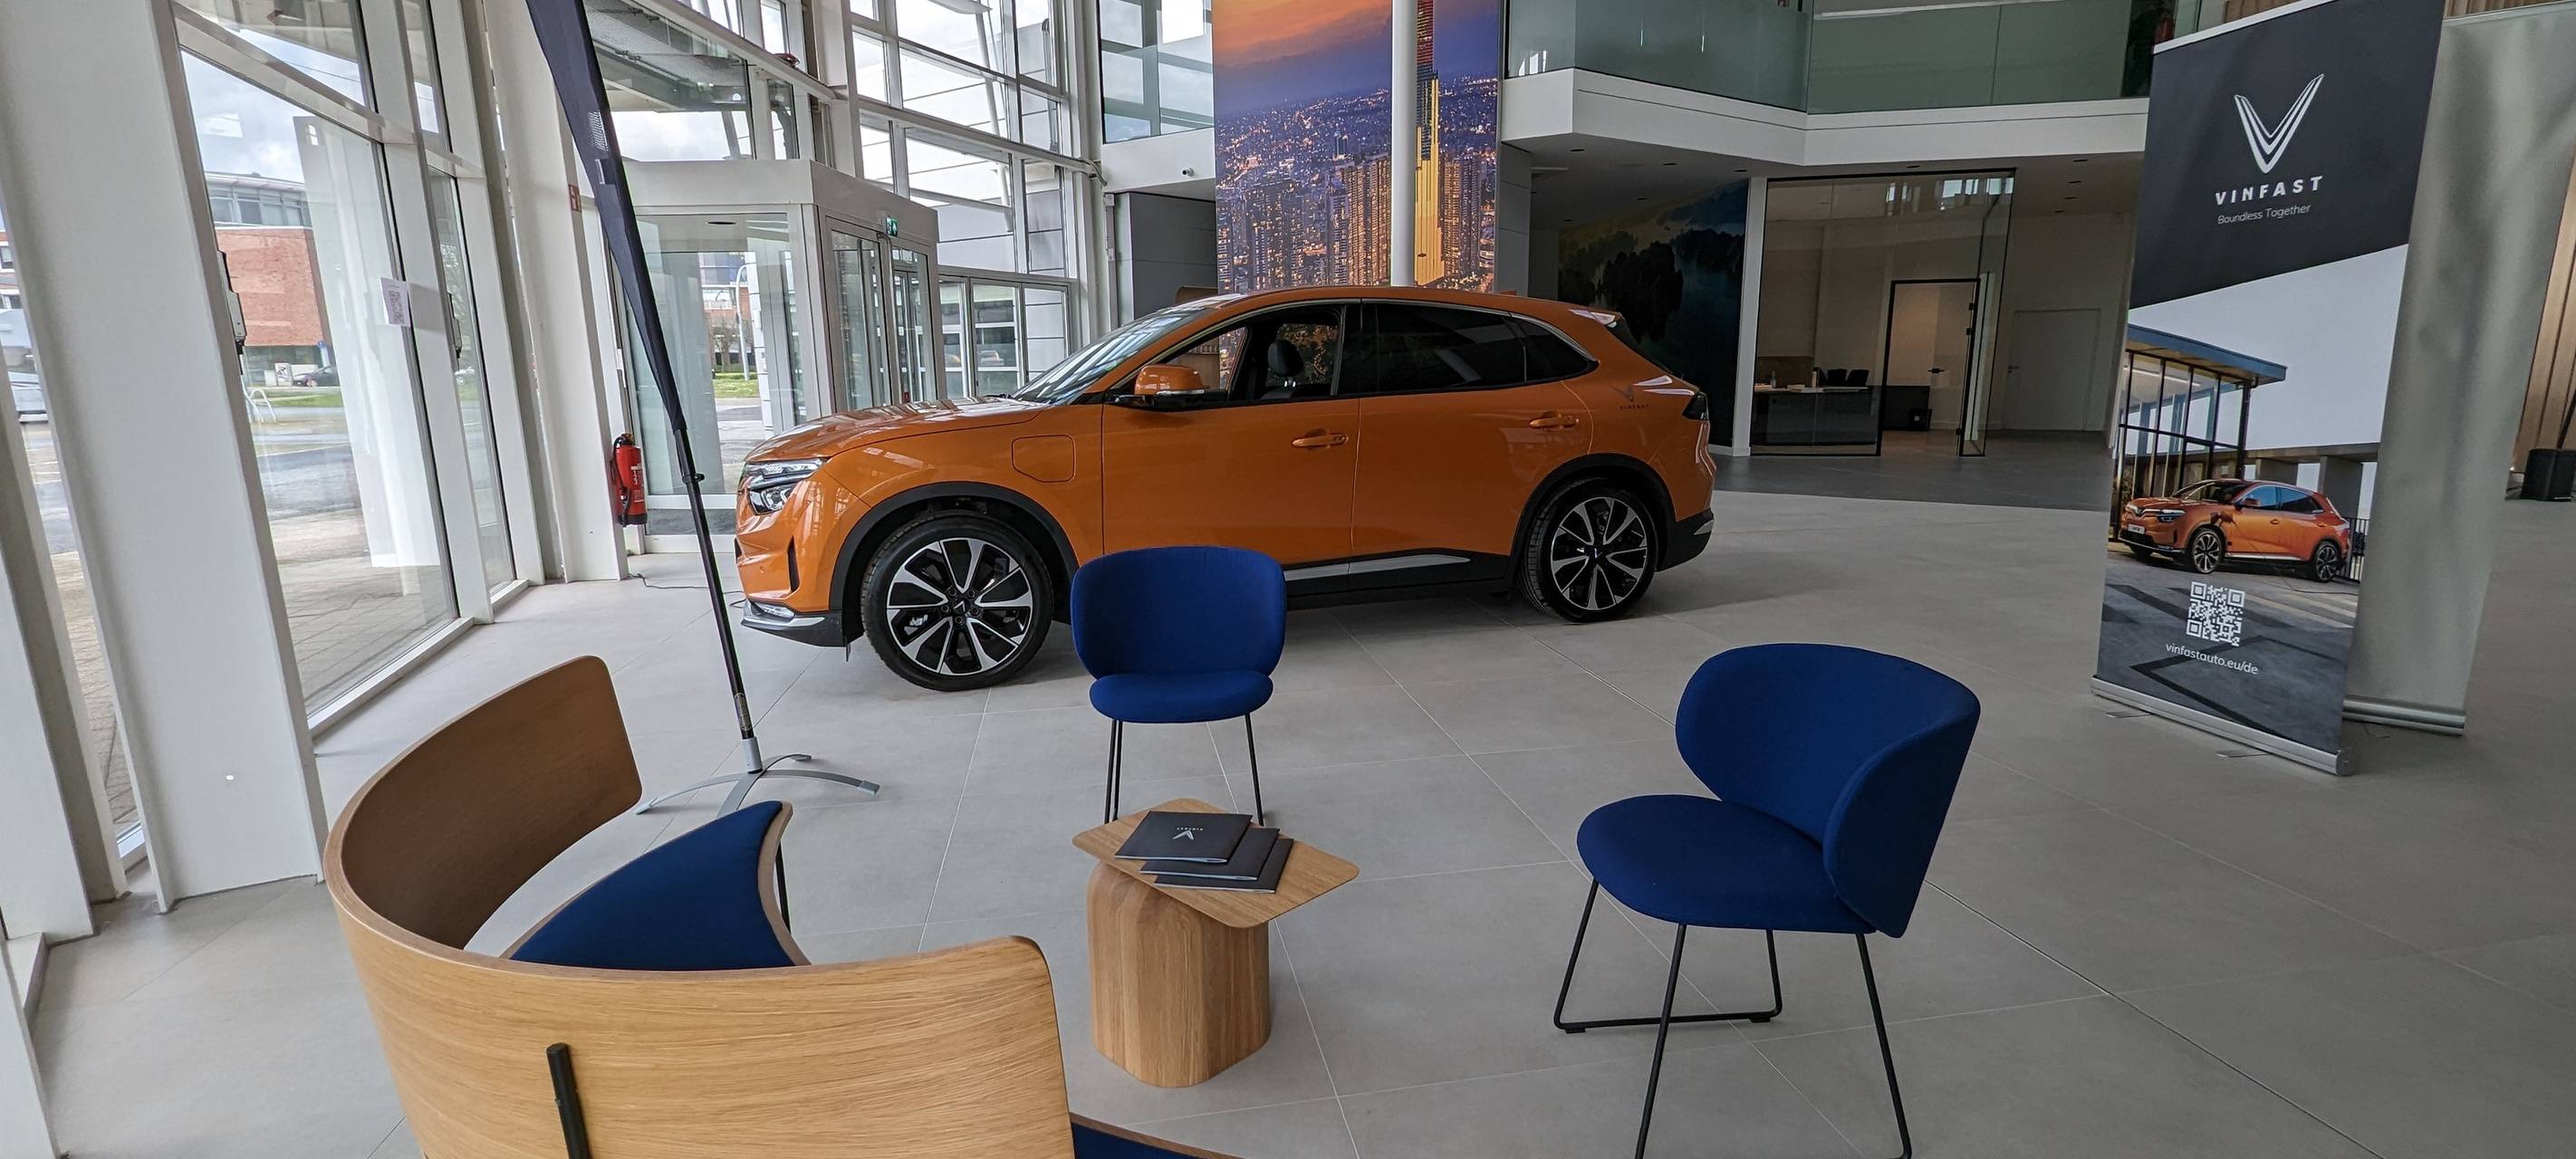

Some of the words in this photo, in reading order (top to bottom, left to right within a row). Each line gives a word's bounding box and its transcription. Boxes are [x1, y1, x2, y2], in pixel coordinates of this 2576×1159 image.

[2216, 176, 2322, 206] VINFAST
[2217, 211, 2263, 225] Boundless
[2265, 205, 2312, 219] Together
[2166, 643, 2259, 675] vinfastauto.eu/de
